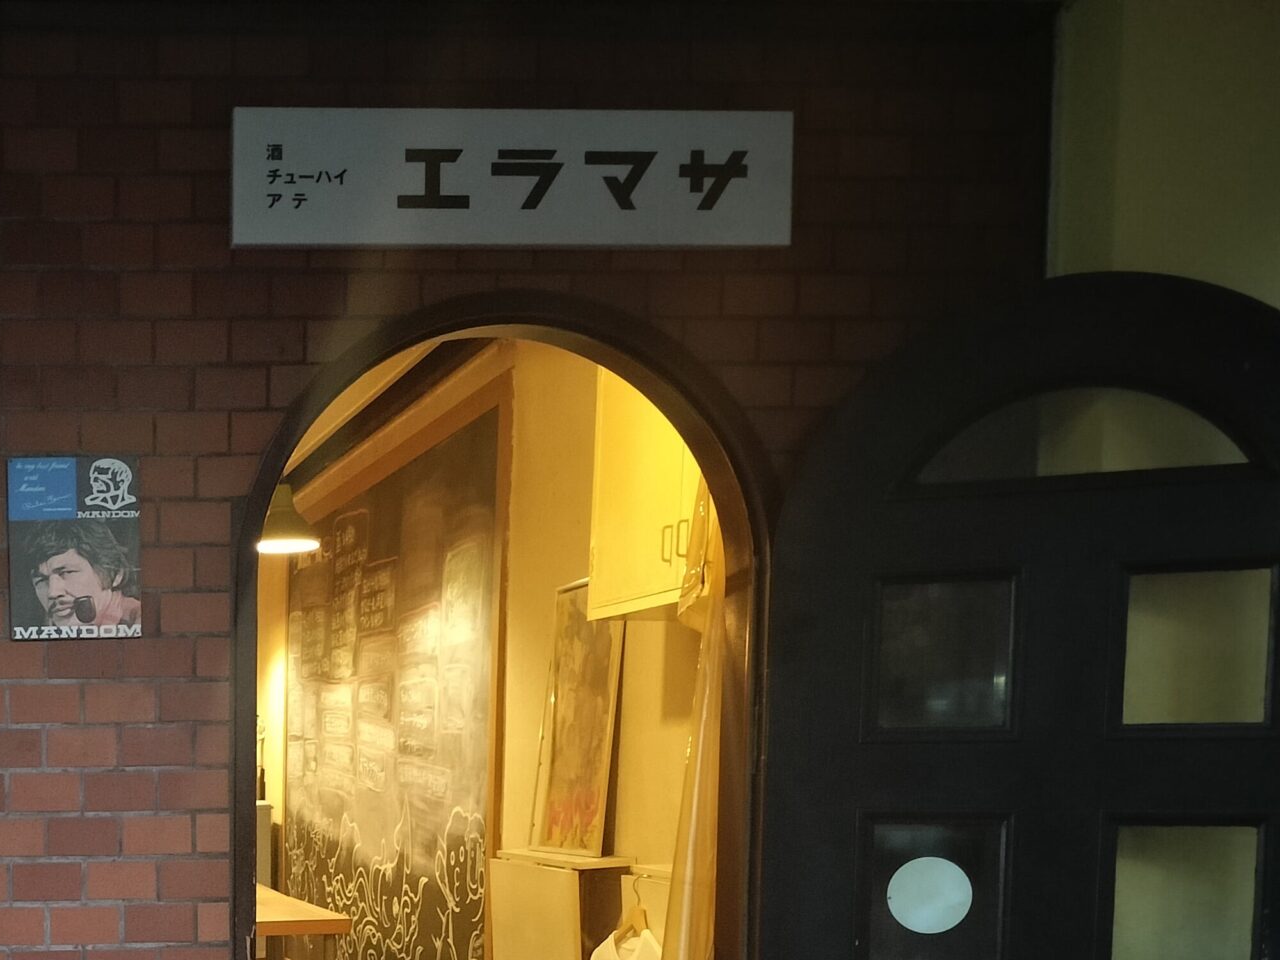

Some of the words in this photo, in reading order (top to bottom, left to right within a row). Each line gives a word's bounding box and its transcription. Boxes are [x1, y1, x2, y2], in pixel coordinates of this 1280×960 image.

[266, 144, 283, 160] 酒
[266, 168, 348, 185] チューハイ
[397, 148, 749, 211] エラマサ
